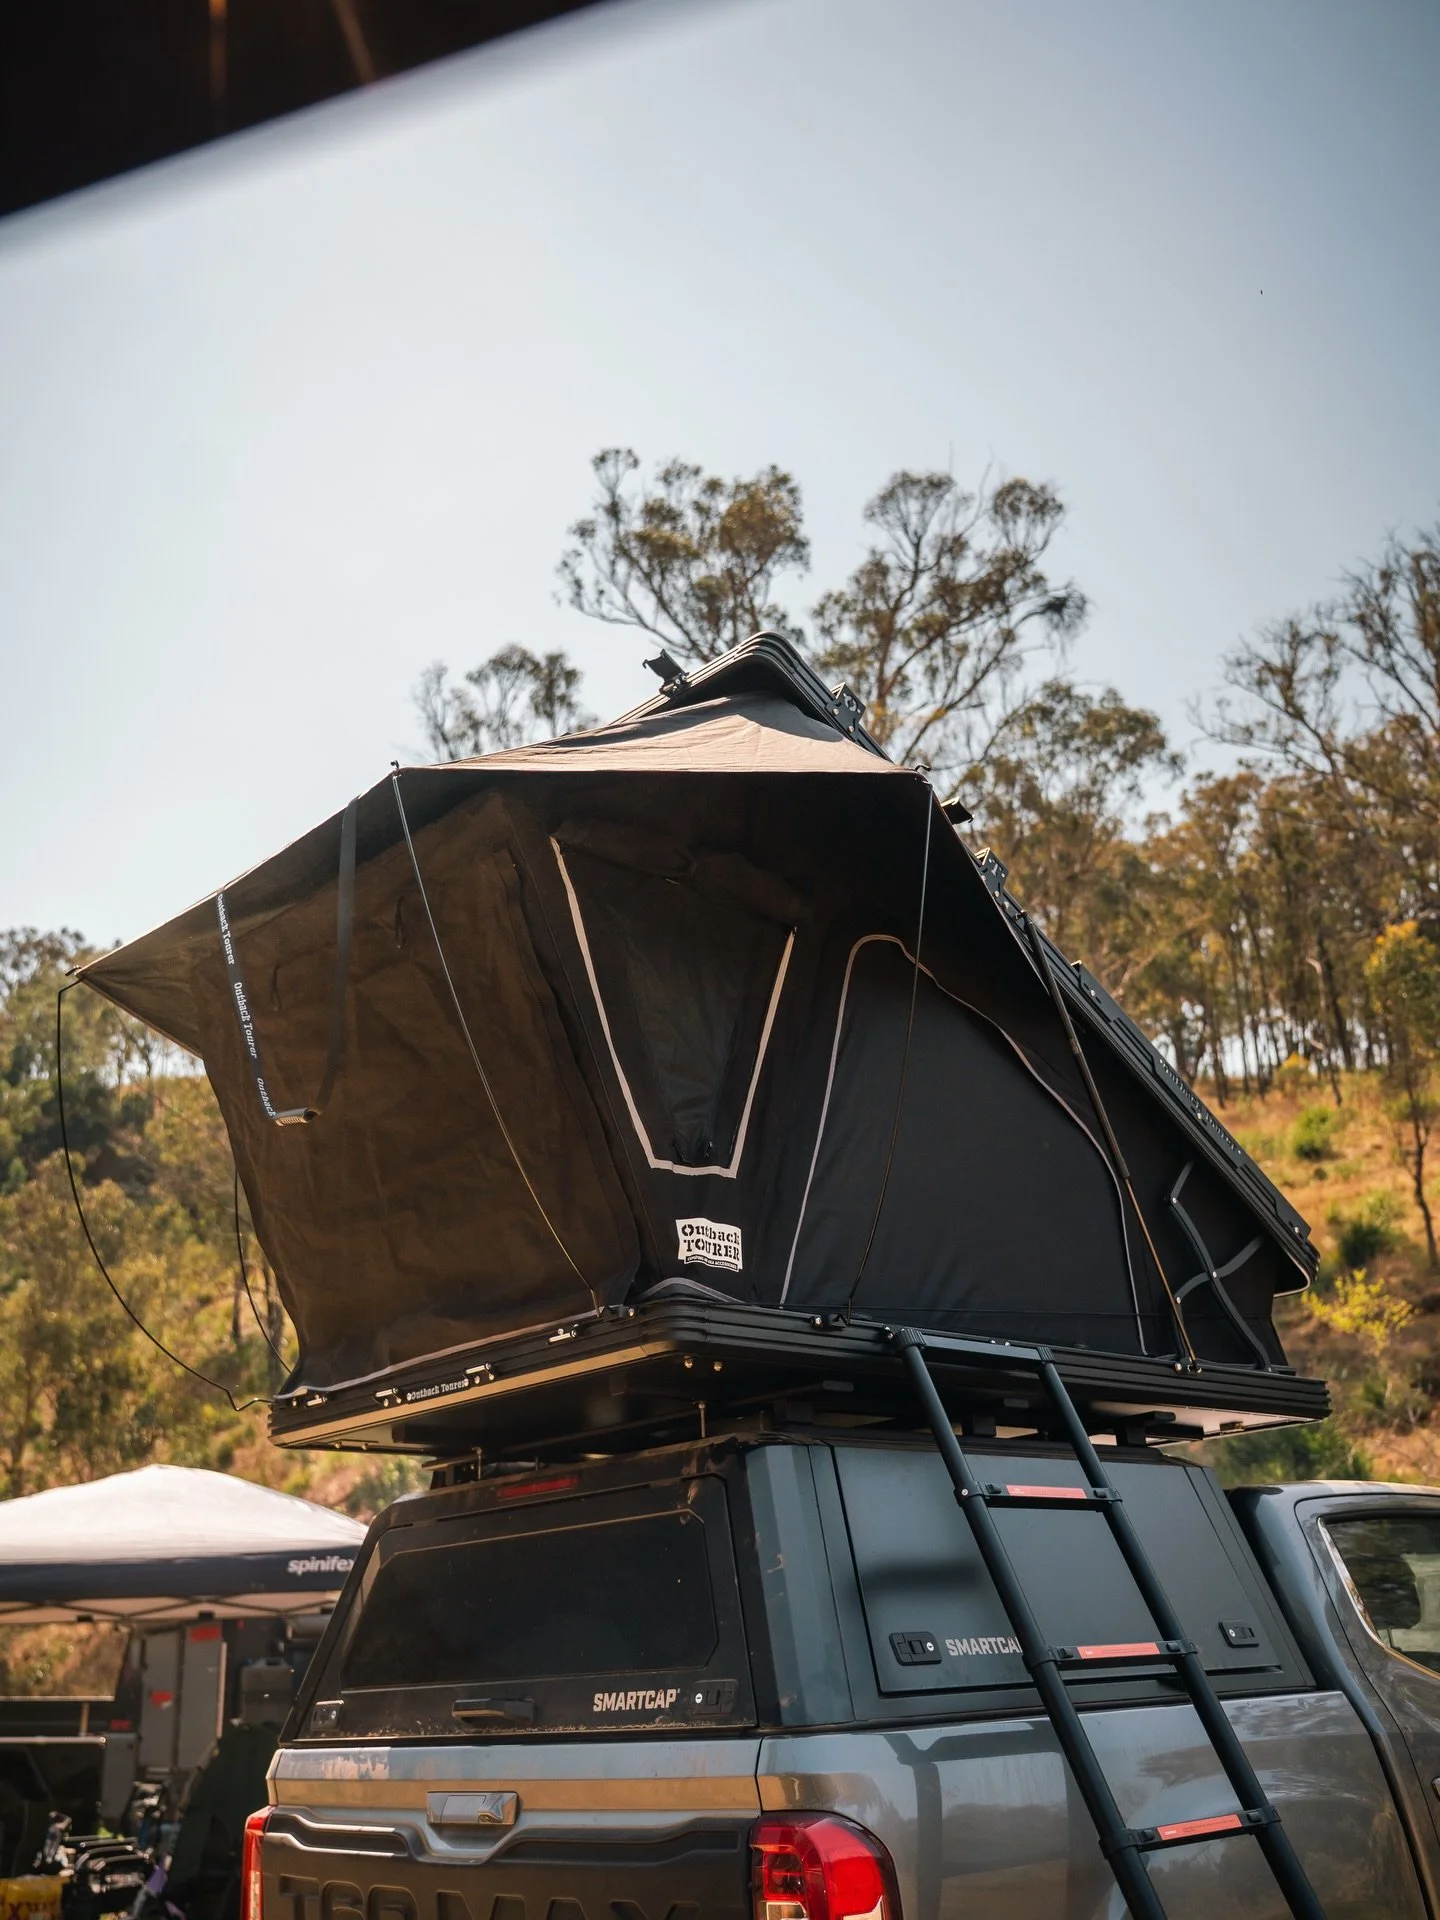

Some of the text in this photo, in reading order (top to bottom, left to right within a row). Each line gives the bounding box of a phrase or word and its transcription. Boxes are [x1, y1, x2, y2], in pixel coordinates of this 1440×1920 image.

[217, 893, 235, 965] Outback Tourer
[234, 981, 251, 1022] Outback
[257, 1077, 276, 1118] Outback
[681, 1223, 740, 1246] Outback
[683, 1238, 740, 1262] TOURER
[411, 1385, 440, 1400] Outback
[944, 1636, 1023, 1656] SMARTCA
[593, 1688, 678, 1712] SMARTCAP
